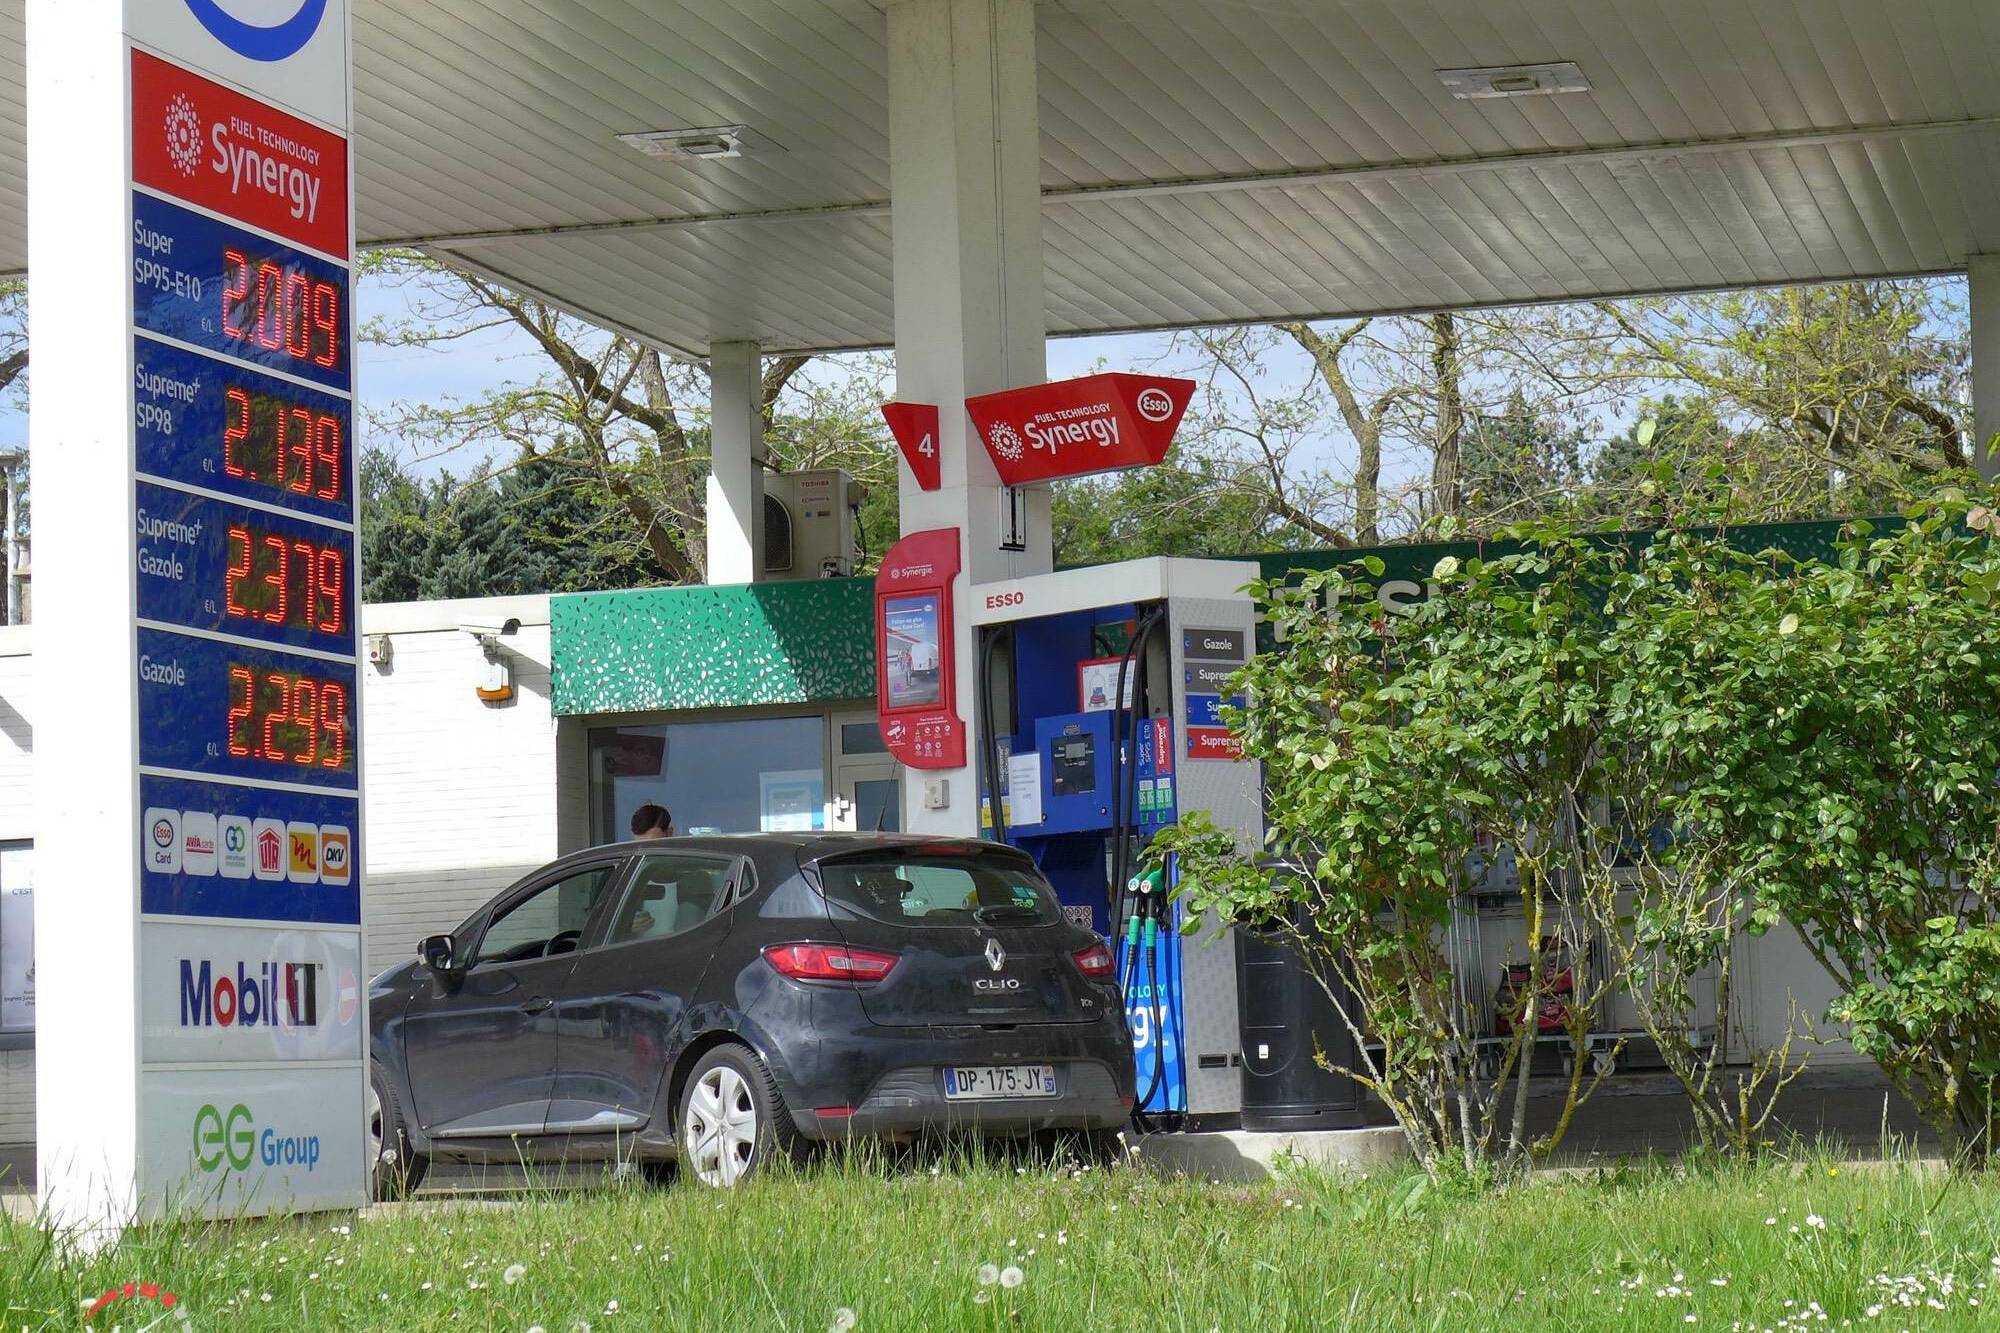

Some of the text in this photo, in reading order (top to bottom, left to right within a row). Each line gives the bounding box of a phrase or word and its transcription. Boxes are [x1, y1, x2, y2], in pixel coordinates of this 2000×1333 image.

[231, 116, 320, 166] FUEL TECHNOLOGY
[212, 122, 320, 224] Synergy
[134, 219, 174, 257] Super
[134, 258, 201, 302] SP95-E10
[136, 402, 172, 435] SP98
[1035, 403, 1111, 424] FUEL TECHNOLOGY
[1143, 396, 1168, 412] Esso
[224, 386, 340, 501] 2.139
[918, 432, 934, 458] 4
[1024, 416, 1120, 455] Synergy
[138, 547, 184, 581] Gazole
[902, 567, 933, 579] Synergie
[225, 528, 342, 633] 2.379
[986, 591, 1024, 609] ESSO
[1203, 638, 1233, 650] Gazole
[139, 655, 185, 686] Gazole
[1199, 669, 1228, 683] Supre
[228, 667, 345, 768] 2.299
[156, 825, 171, 839] Esso
[155, 851, 172, 864] Card
[326, 848, 344, 862] DKV
[180, 959, 278, 1027] Mobil
[975, 979, 1020, 989] CLIO
[260, 1128, 319, 1171] Group
